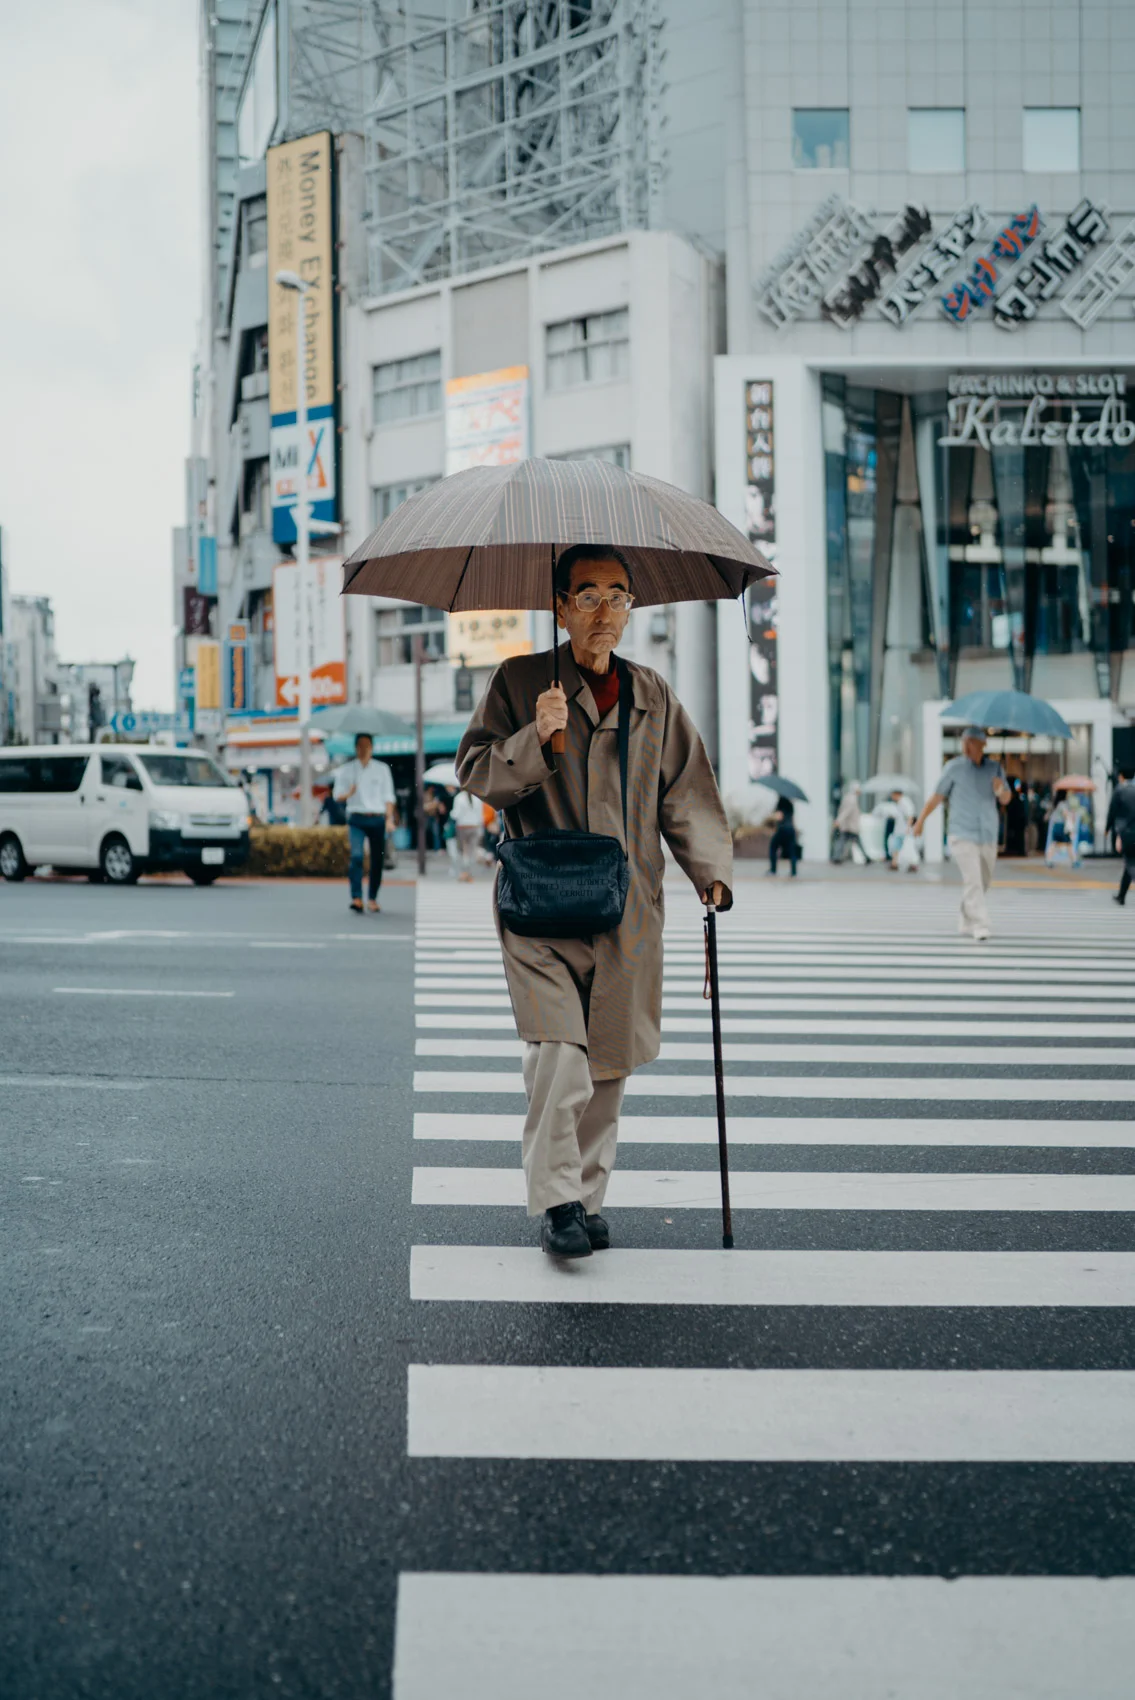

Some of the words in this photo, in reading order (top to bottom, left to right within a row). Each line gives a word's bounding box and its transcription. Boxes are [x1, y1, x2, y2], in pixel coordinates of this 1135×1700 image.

[298, 149, 321, 245] Money
[948, 374, 1054, 396] PACHINKO
[1076, 373, 1127, 395] SLOT
[937, 393, 1135, 450] Kaleido
[559, 889, 593, 897] CERRUTI
